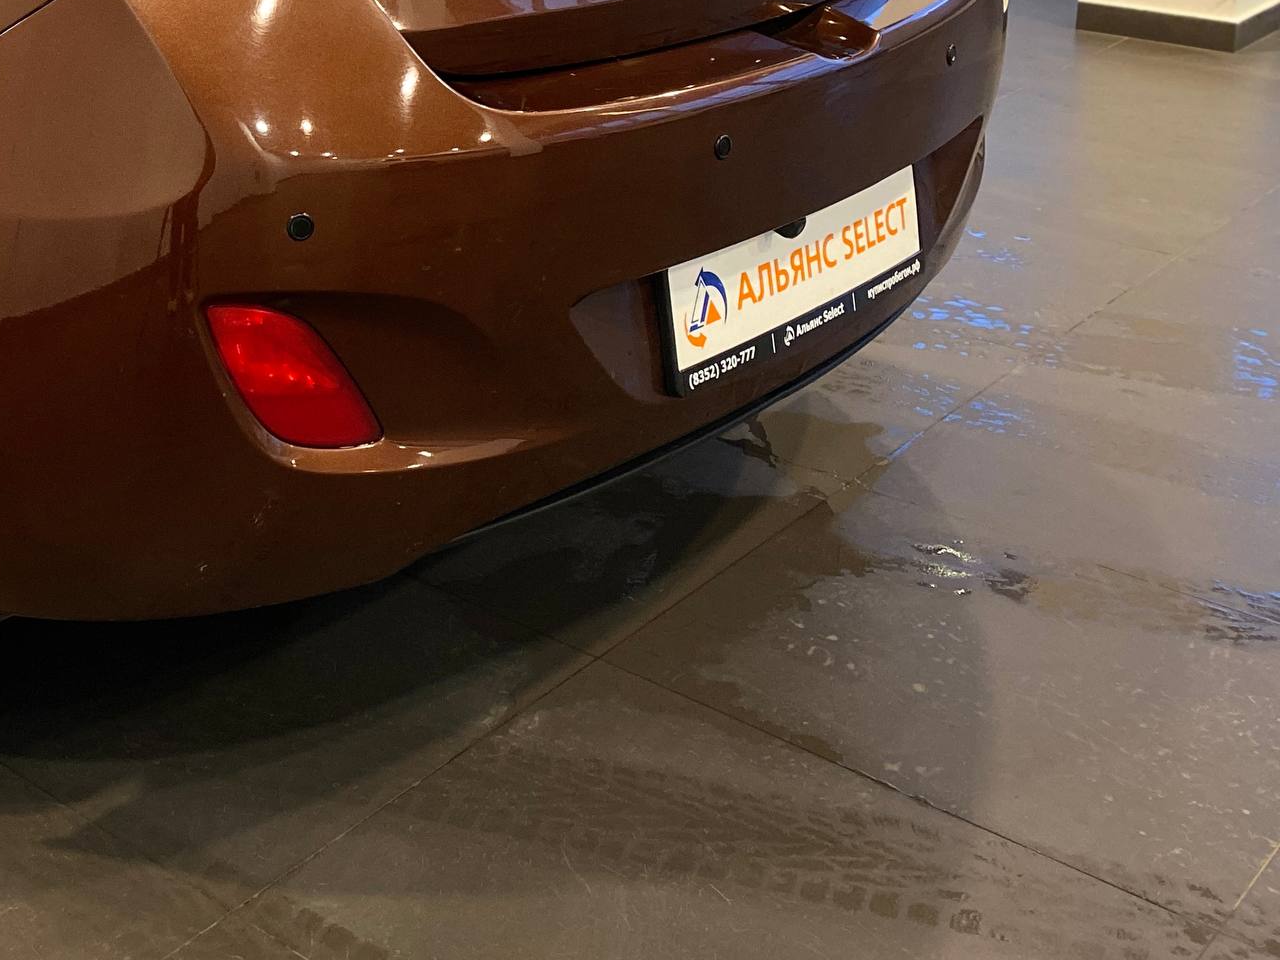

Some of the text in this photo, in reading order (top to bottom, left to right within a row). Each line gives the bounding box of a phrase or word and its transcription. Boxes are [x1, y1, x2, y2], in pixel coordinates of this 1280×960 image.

[737, 197, 908, 310] АЛЬЯНС SELECT
[689, 364, 720, 390] (8352)
[721, 346, 756, 373] 320-777
[796, 315, 823, 337] Альянс
[823, 302, 845, 323] Select
